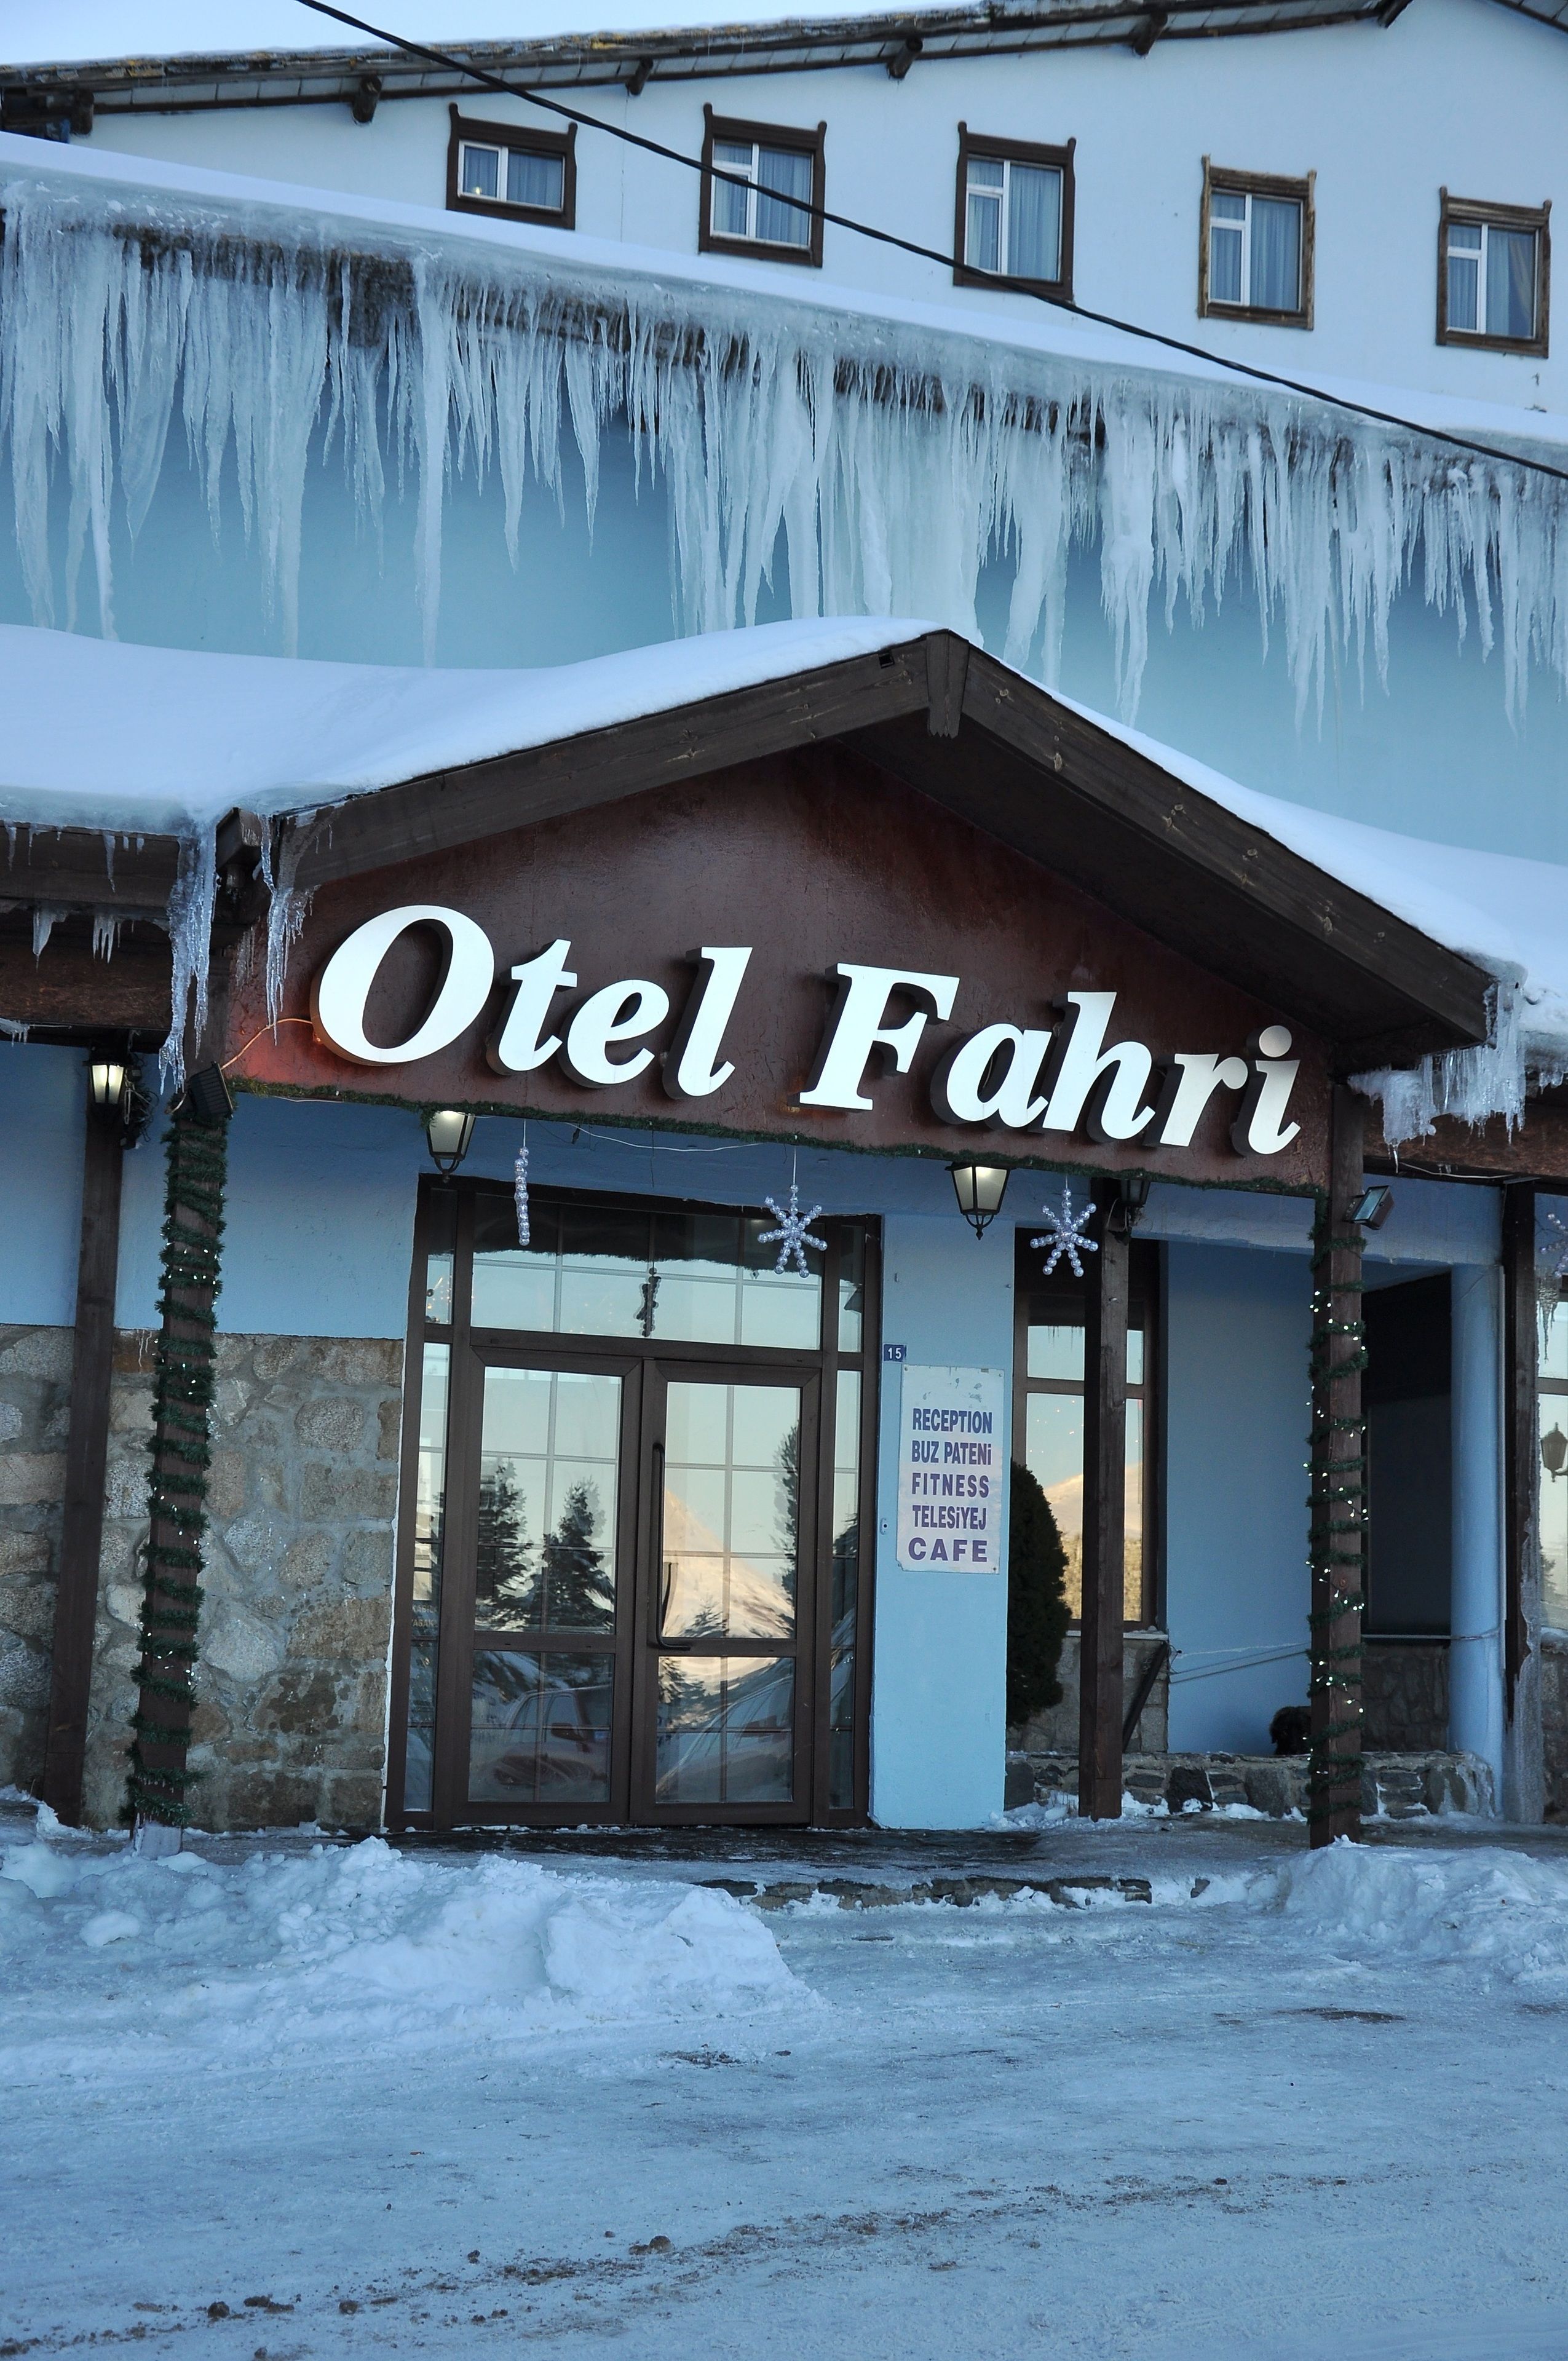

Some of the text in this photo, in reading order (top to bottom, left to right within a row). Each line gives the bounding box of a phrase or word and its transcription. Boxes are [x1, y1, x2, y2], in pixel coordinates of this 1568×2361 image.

[312, 904, 1301, 1155] Otel Fahri
[888, 1347, 901, 1359] 15
[913, 1408, 992, 1434] RECEPTION
[911, 1441, 939, 1463] BUZ
[911, 1473, 989, 1498] FITNESS
[908, 1537, 988, 1562] CAFE
